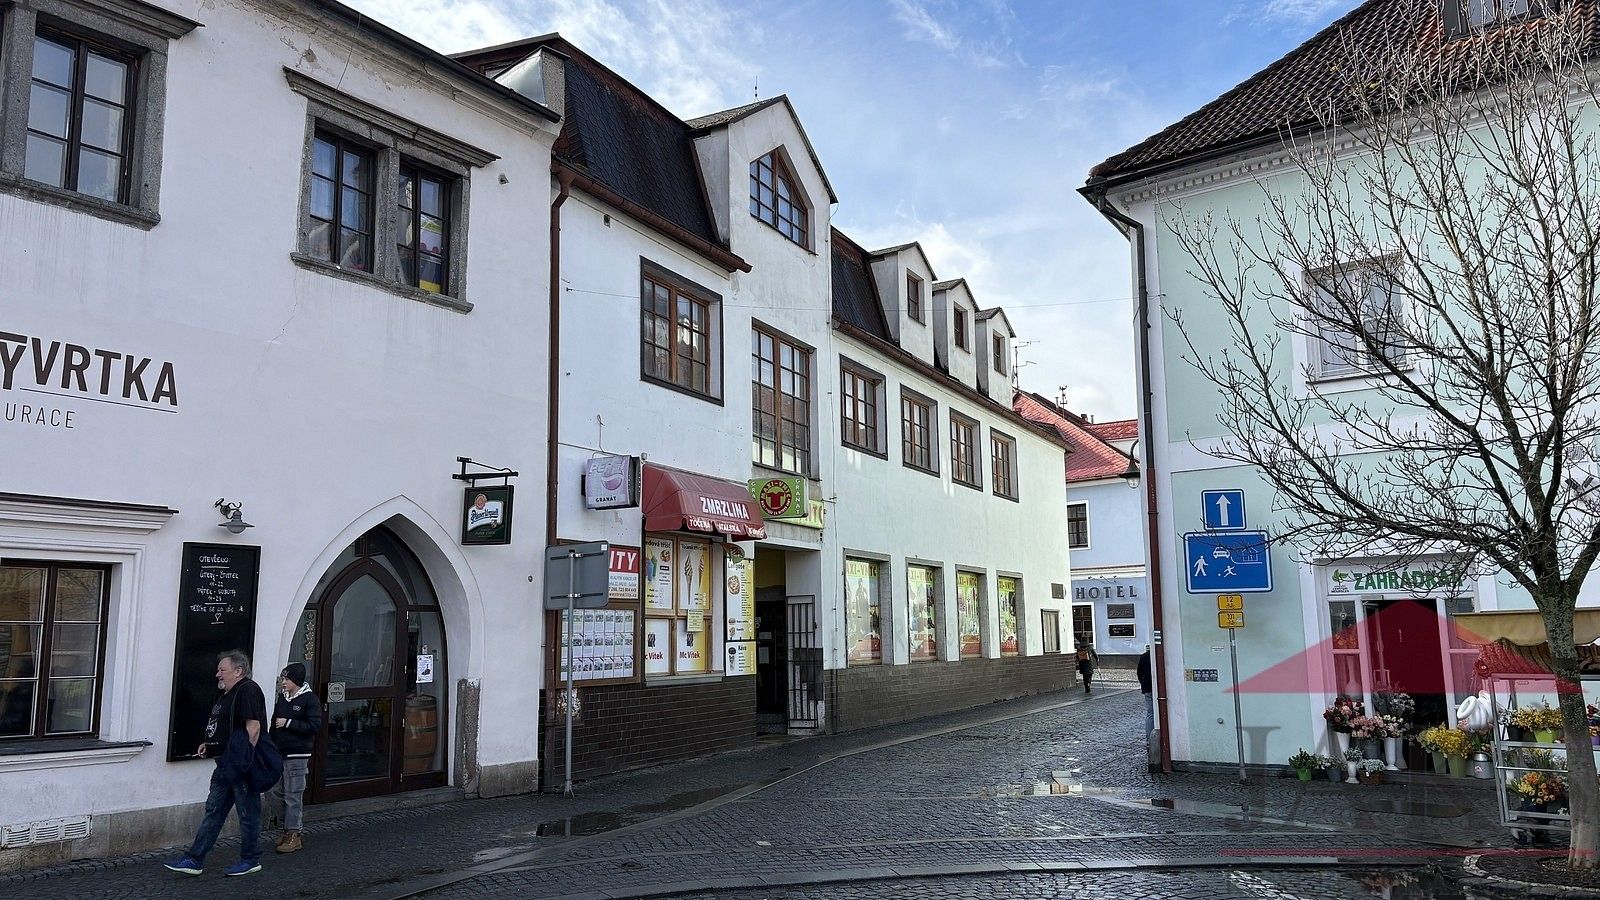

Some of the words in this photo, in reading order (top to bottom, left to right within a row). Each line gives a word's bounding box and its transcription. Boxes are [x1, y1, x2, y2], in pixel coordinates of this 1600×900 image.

[5, 402, 76, 429] URACE
[700, 496, 750, 519] ZMRZLINA
[1075, 585, 1137, 599] HOTEL
